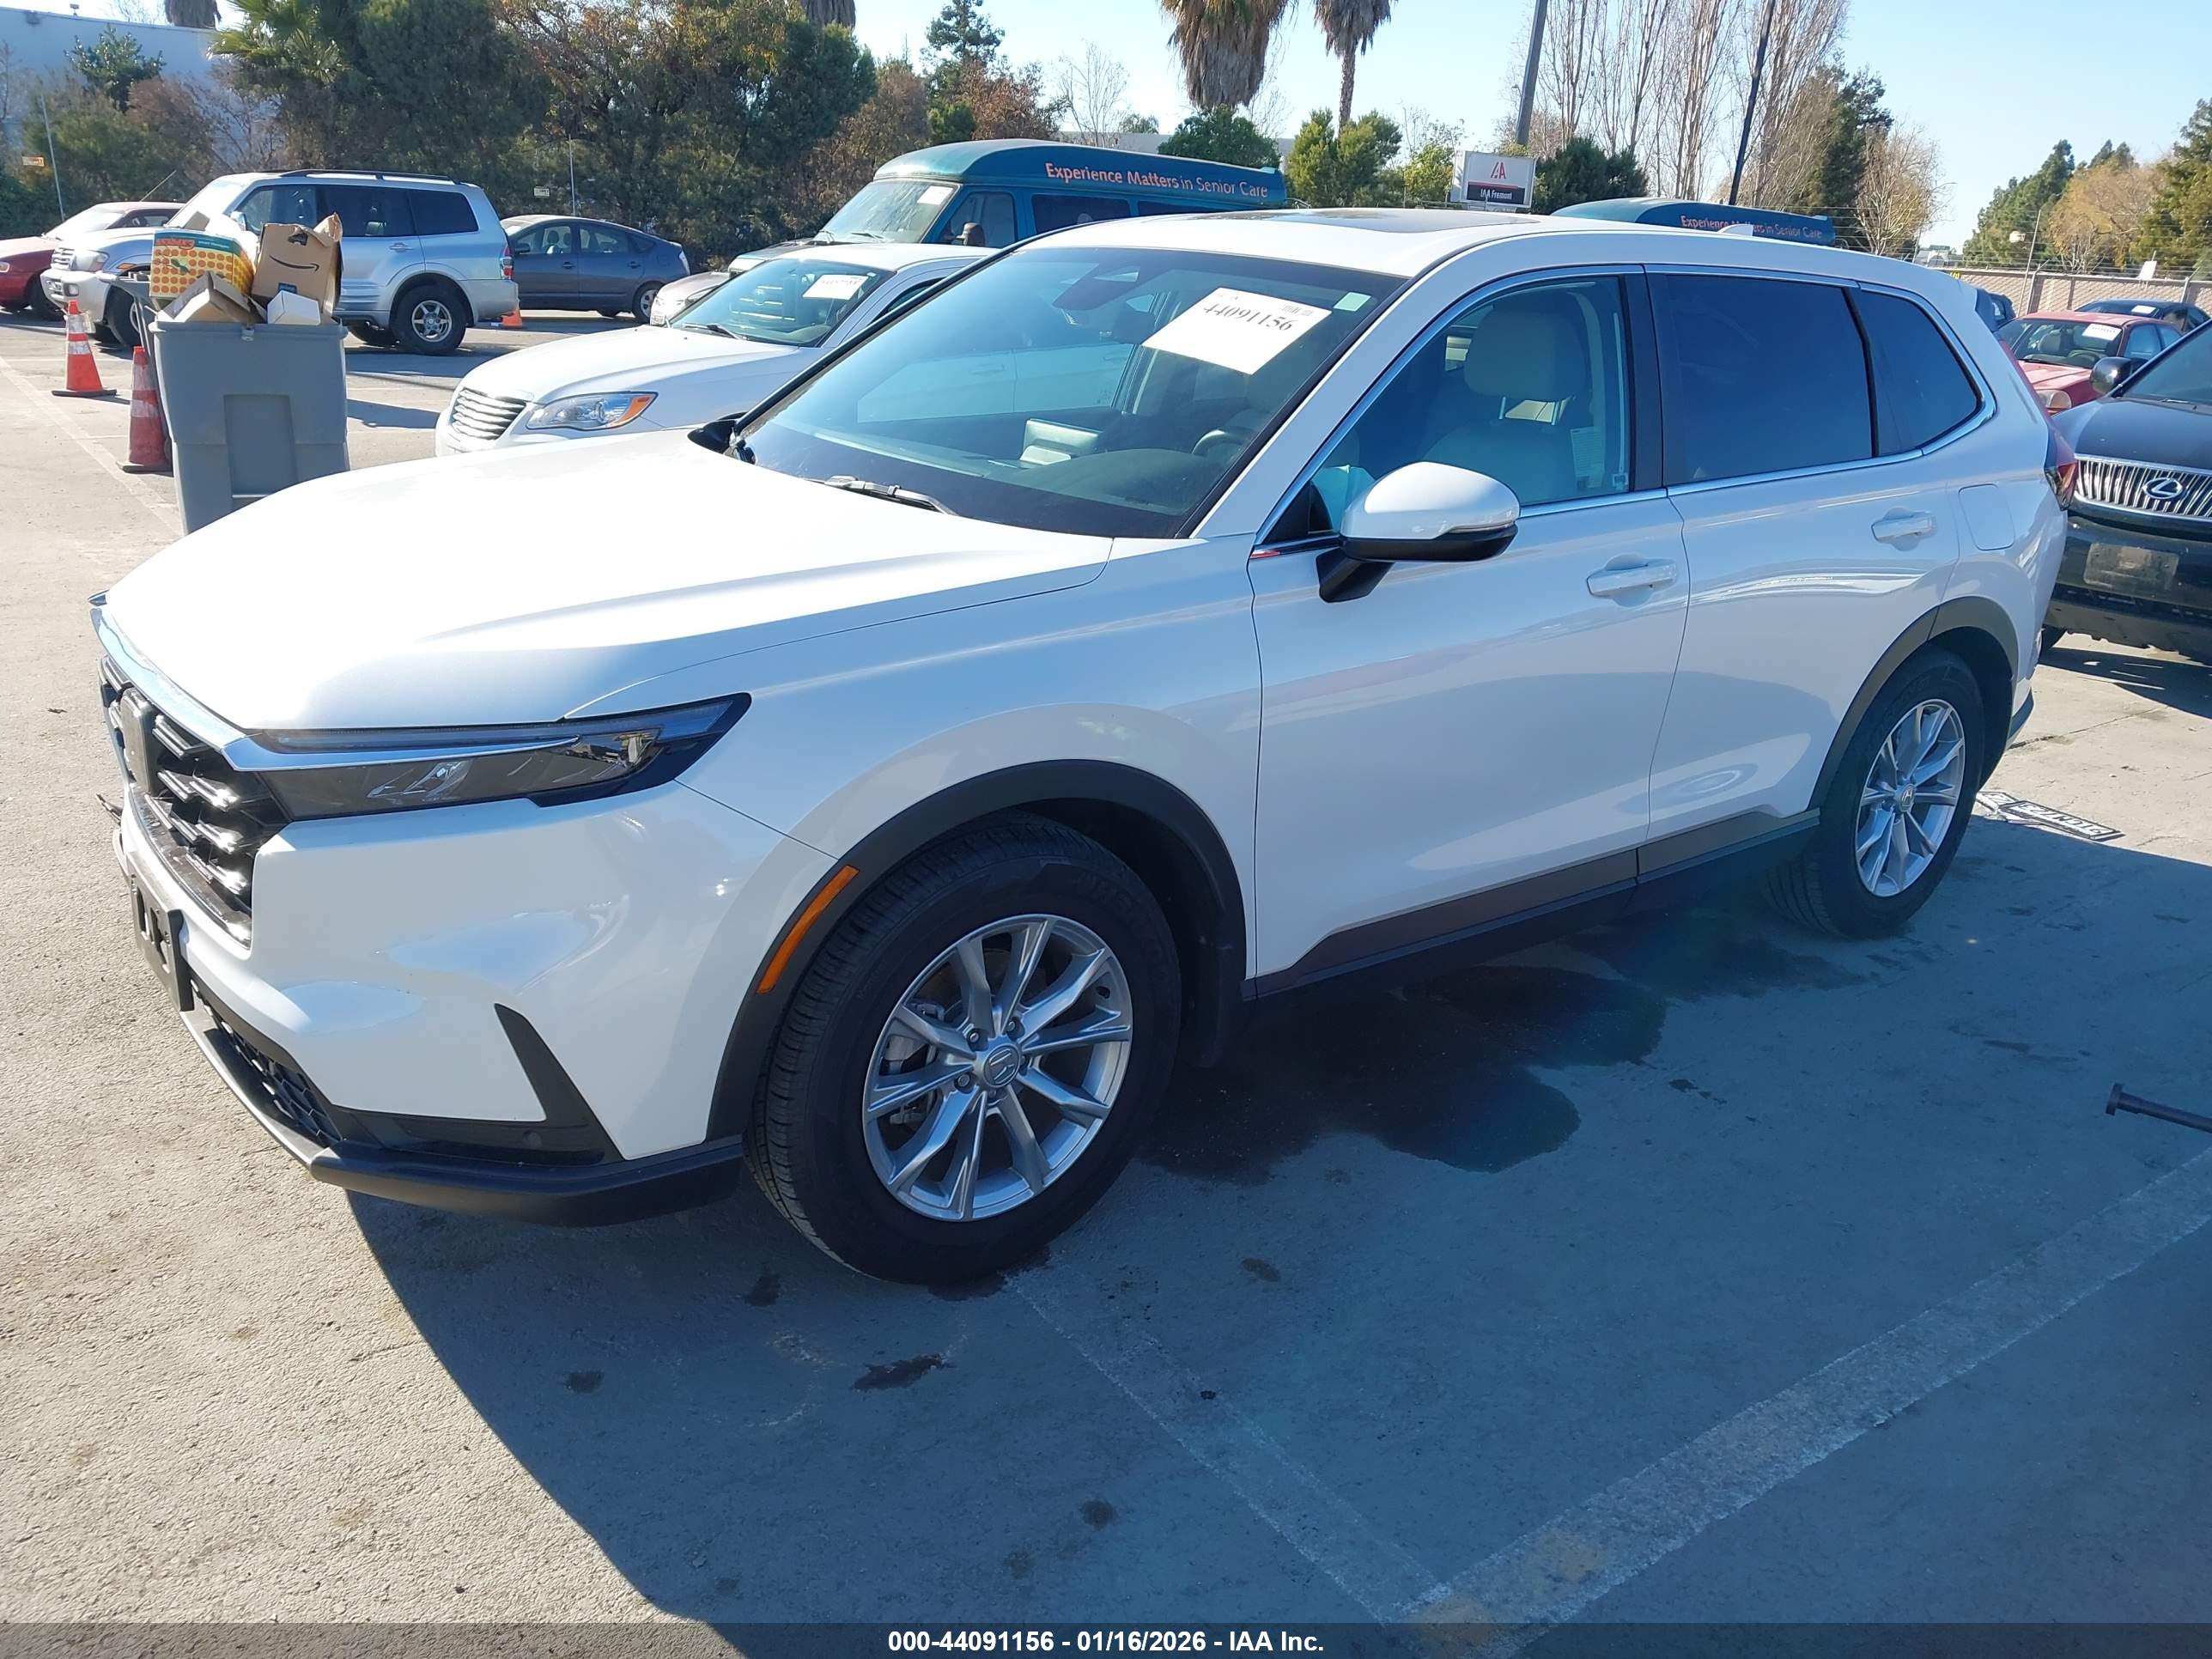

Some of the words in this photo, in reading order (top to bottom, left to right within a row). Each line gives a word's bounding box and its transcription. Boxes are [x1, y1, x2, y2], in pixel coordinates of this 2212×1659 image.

[1045, 162, 1123, 185] Experience
[1127, 170, 1180, 189] Matters
[1181, 178, 1194, 191] in
[1198, 177, 1236, 194] Senior
[1239, 181, 1268, 198] Care
[1492, 190, 1512, 200] Fremont
[1774, 224, 1801, 236] Senior
[1804, 227, 1822, 239] Care
[1204, 303, 1297, 331] 44091156
